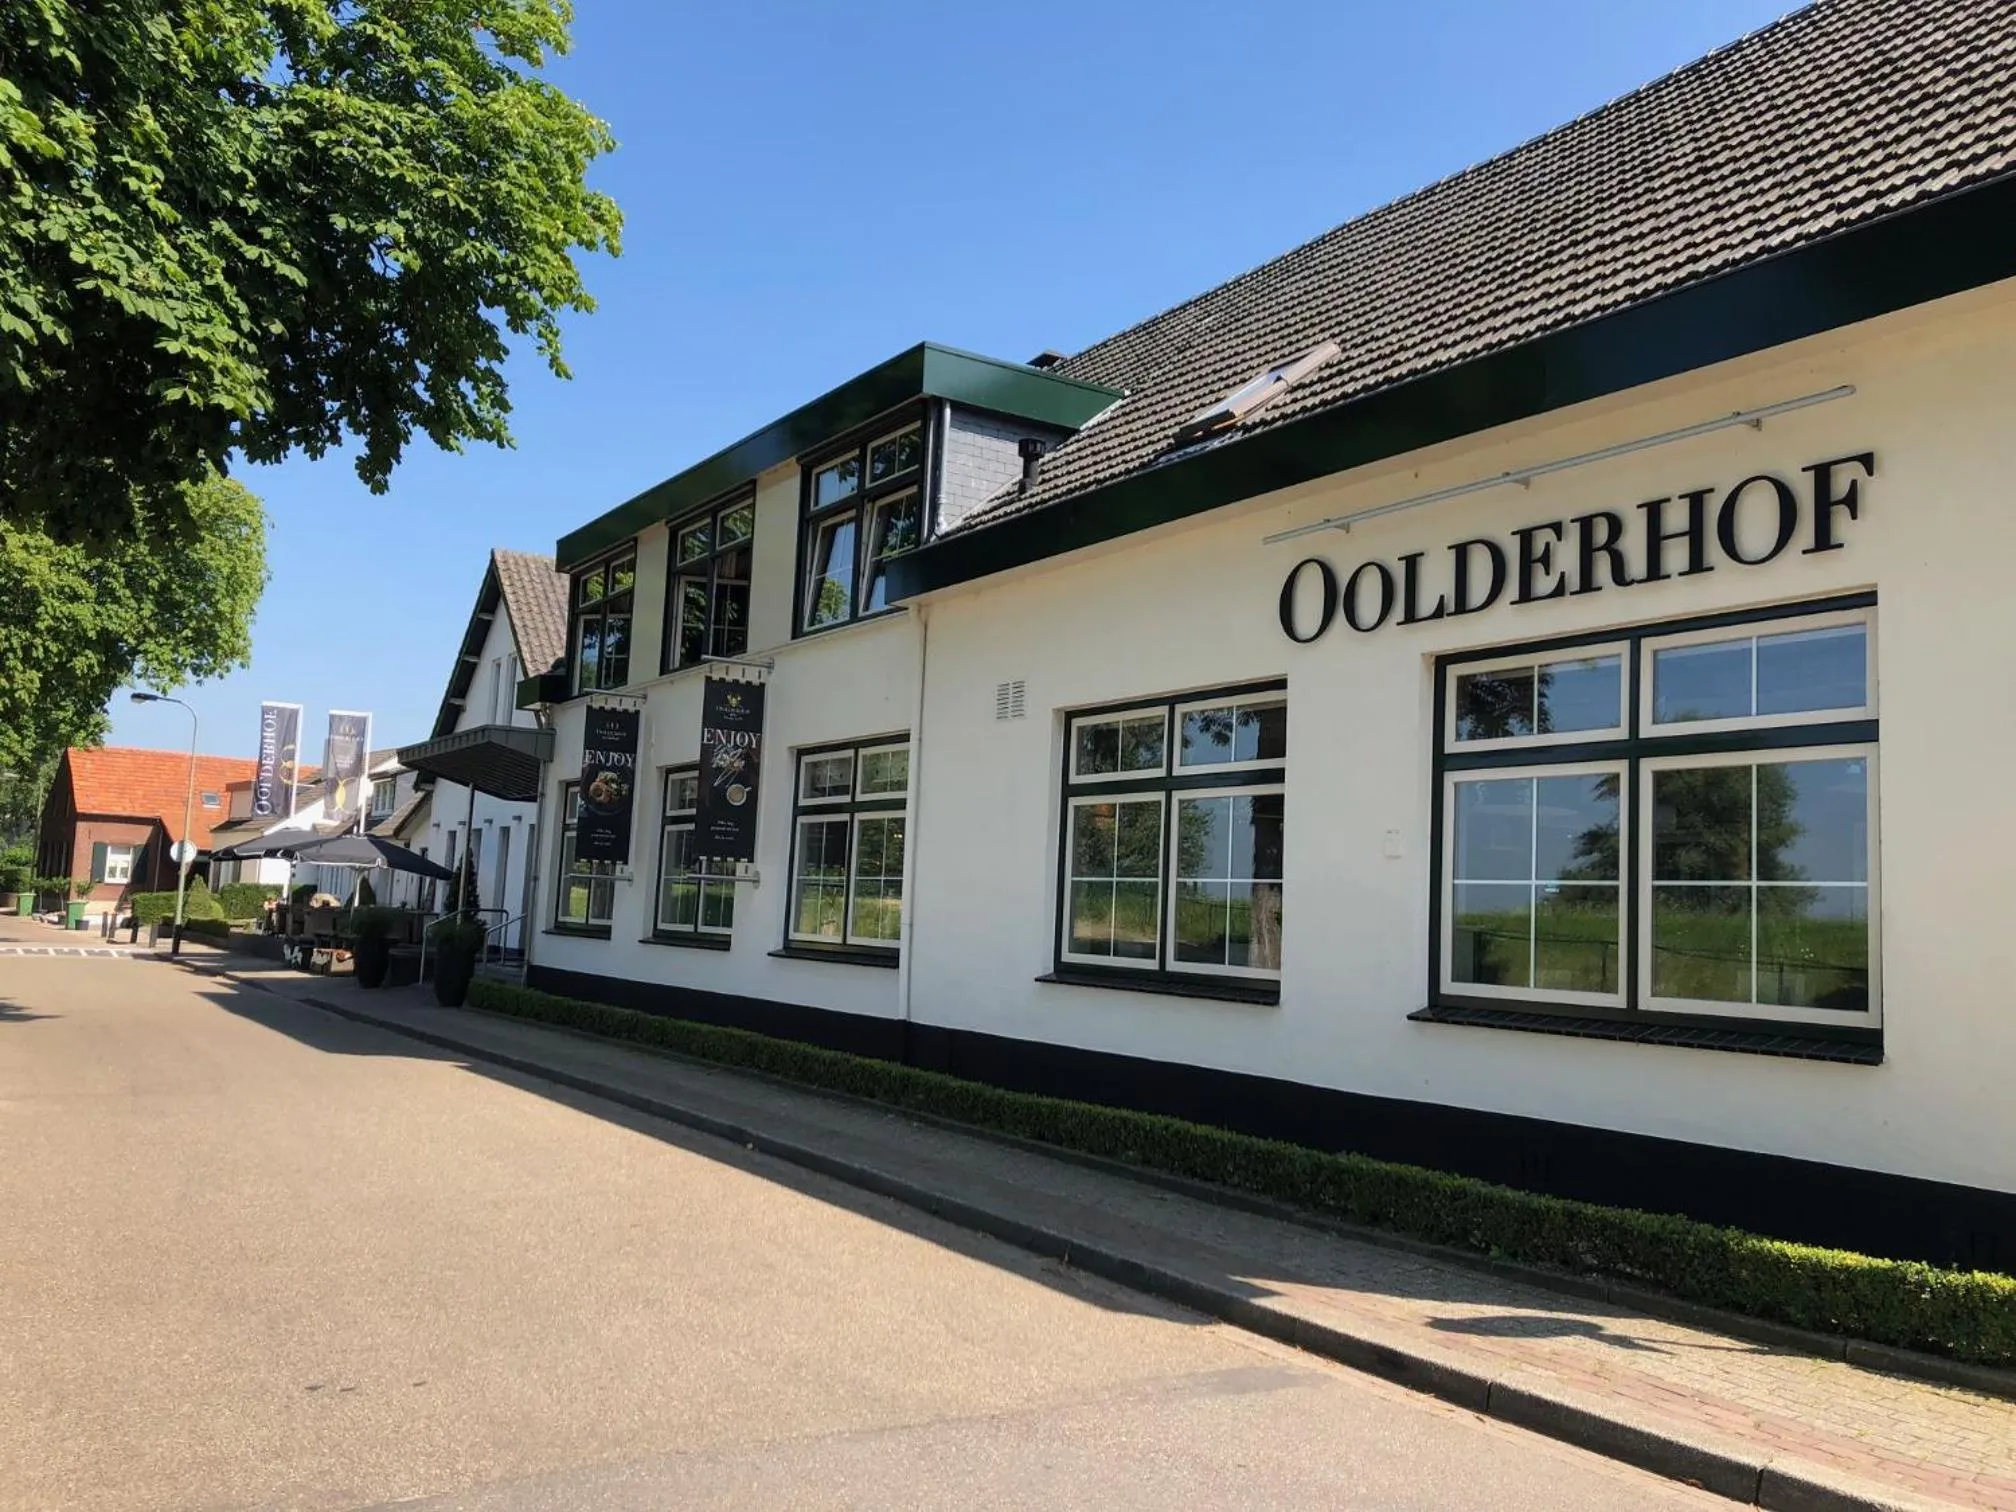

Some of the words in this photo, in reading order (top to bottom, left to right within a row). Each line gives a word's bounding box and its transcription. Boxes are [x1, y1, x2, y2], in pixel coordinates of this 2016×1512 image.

[1279, 452, 1875, 644] OOLDERHOF
[703, 727, 761, 749] ENJOY
[584, 749, 636, 768] ENJOY
